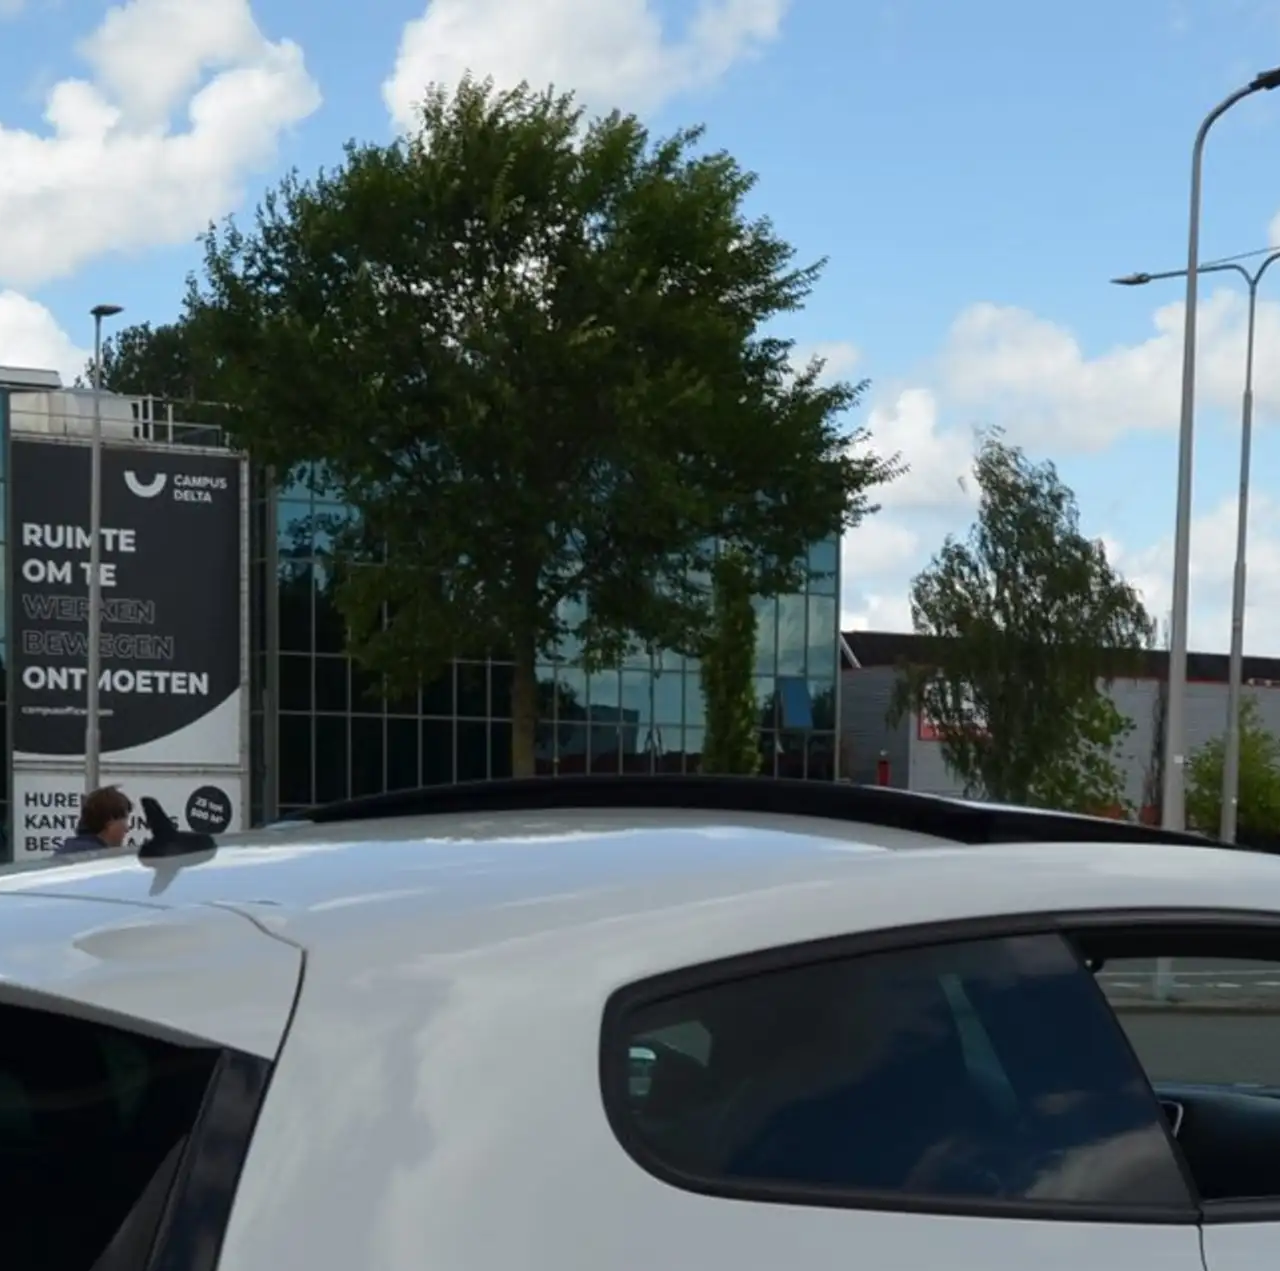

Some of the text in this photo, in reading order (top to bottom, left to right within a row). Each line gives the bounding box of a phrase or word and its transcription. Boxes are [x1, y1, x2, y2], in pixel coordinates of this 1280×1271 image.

[173, 474, 228, 490] CAMPUS
[173, 490, 212, 503] DELTA
[22, 558, 72, 584] OM
